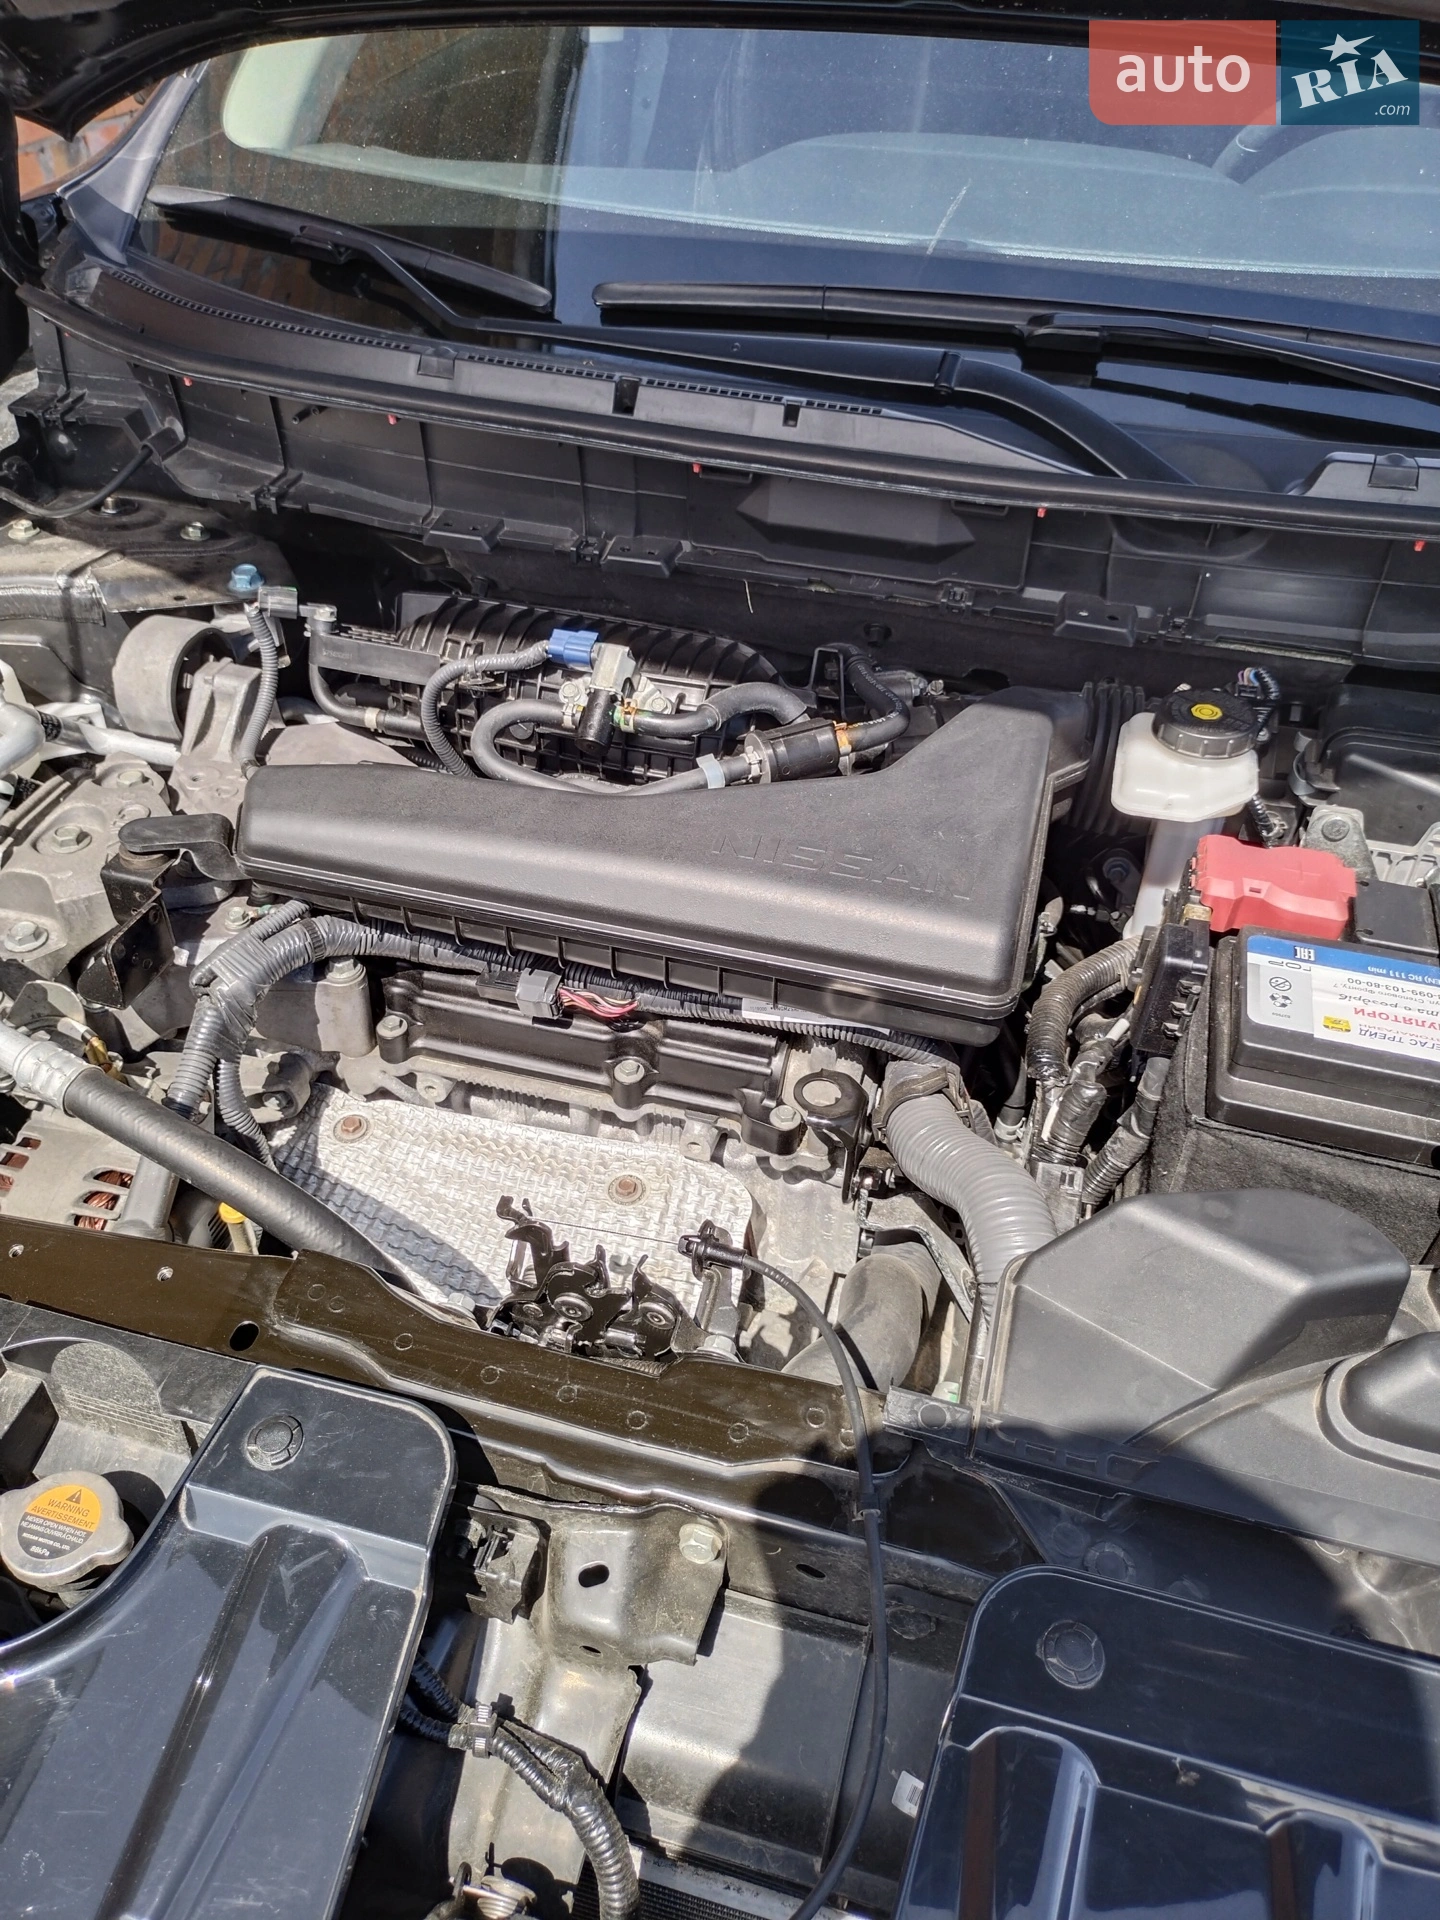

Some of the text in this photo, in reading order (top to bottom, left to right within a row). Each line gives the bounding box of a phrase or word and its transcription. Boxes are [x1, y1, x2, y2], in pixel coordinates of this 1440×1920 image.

[711, 834, 980, 900] NISSAN
[1294, 946, 1315, 961] EAC
[1367, 966, 1387, 974] min
[1389, 970, 1406, 979] 111
[1407, 973, 1422, 982] RC
[1338, 993, 1398, 1009] роздріб
[1378, 991, 1425, 1004] Степового
[1353, 1007, 1440, 1031] УЛЯТОРИ
[1358, 1028, 1404, 1044] ТРЕЙД
[47, 1498, 90, 1517] WARNING
[25, 1515, 43, 1525] NEVER
[43, 1520, 58, 1529] OPEN
[58, 1524, 75, 1535] WHEN
[31, 1505, 96, 1529] AVERTISSEMENT
[30, 1545, 50, 1557] 88kPa
